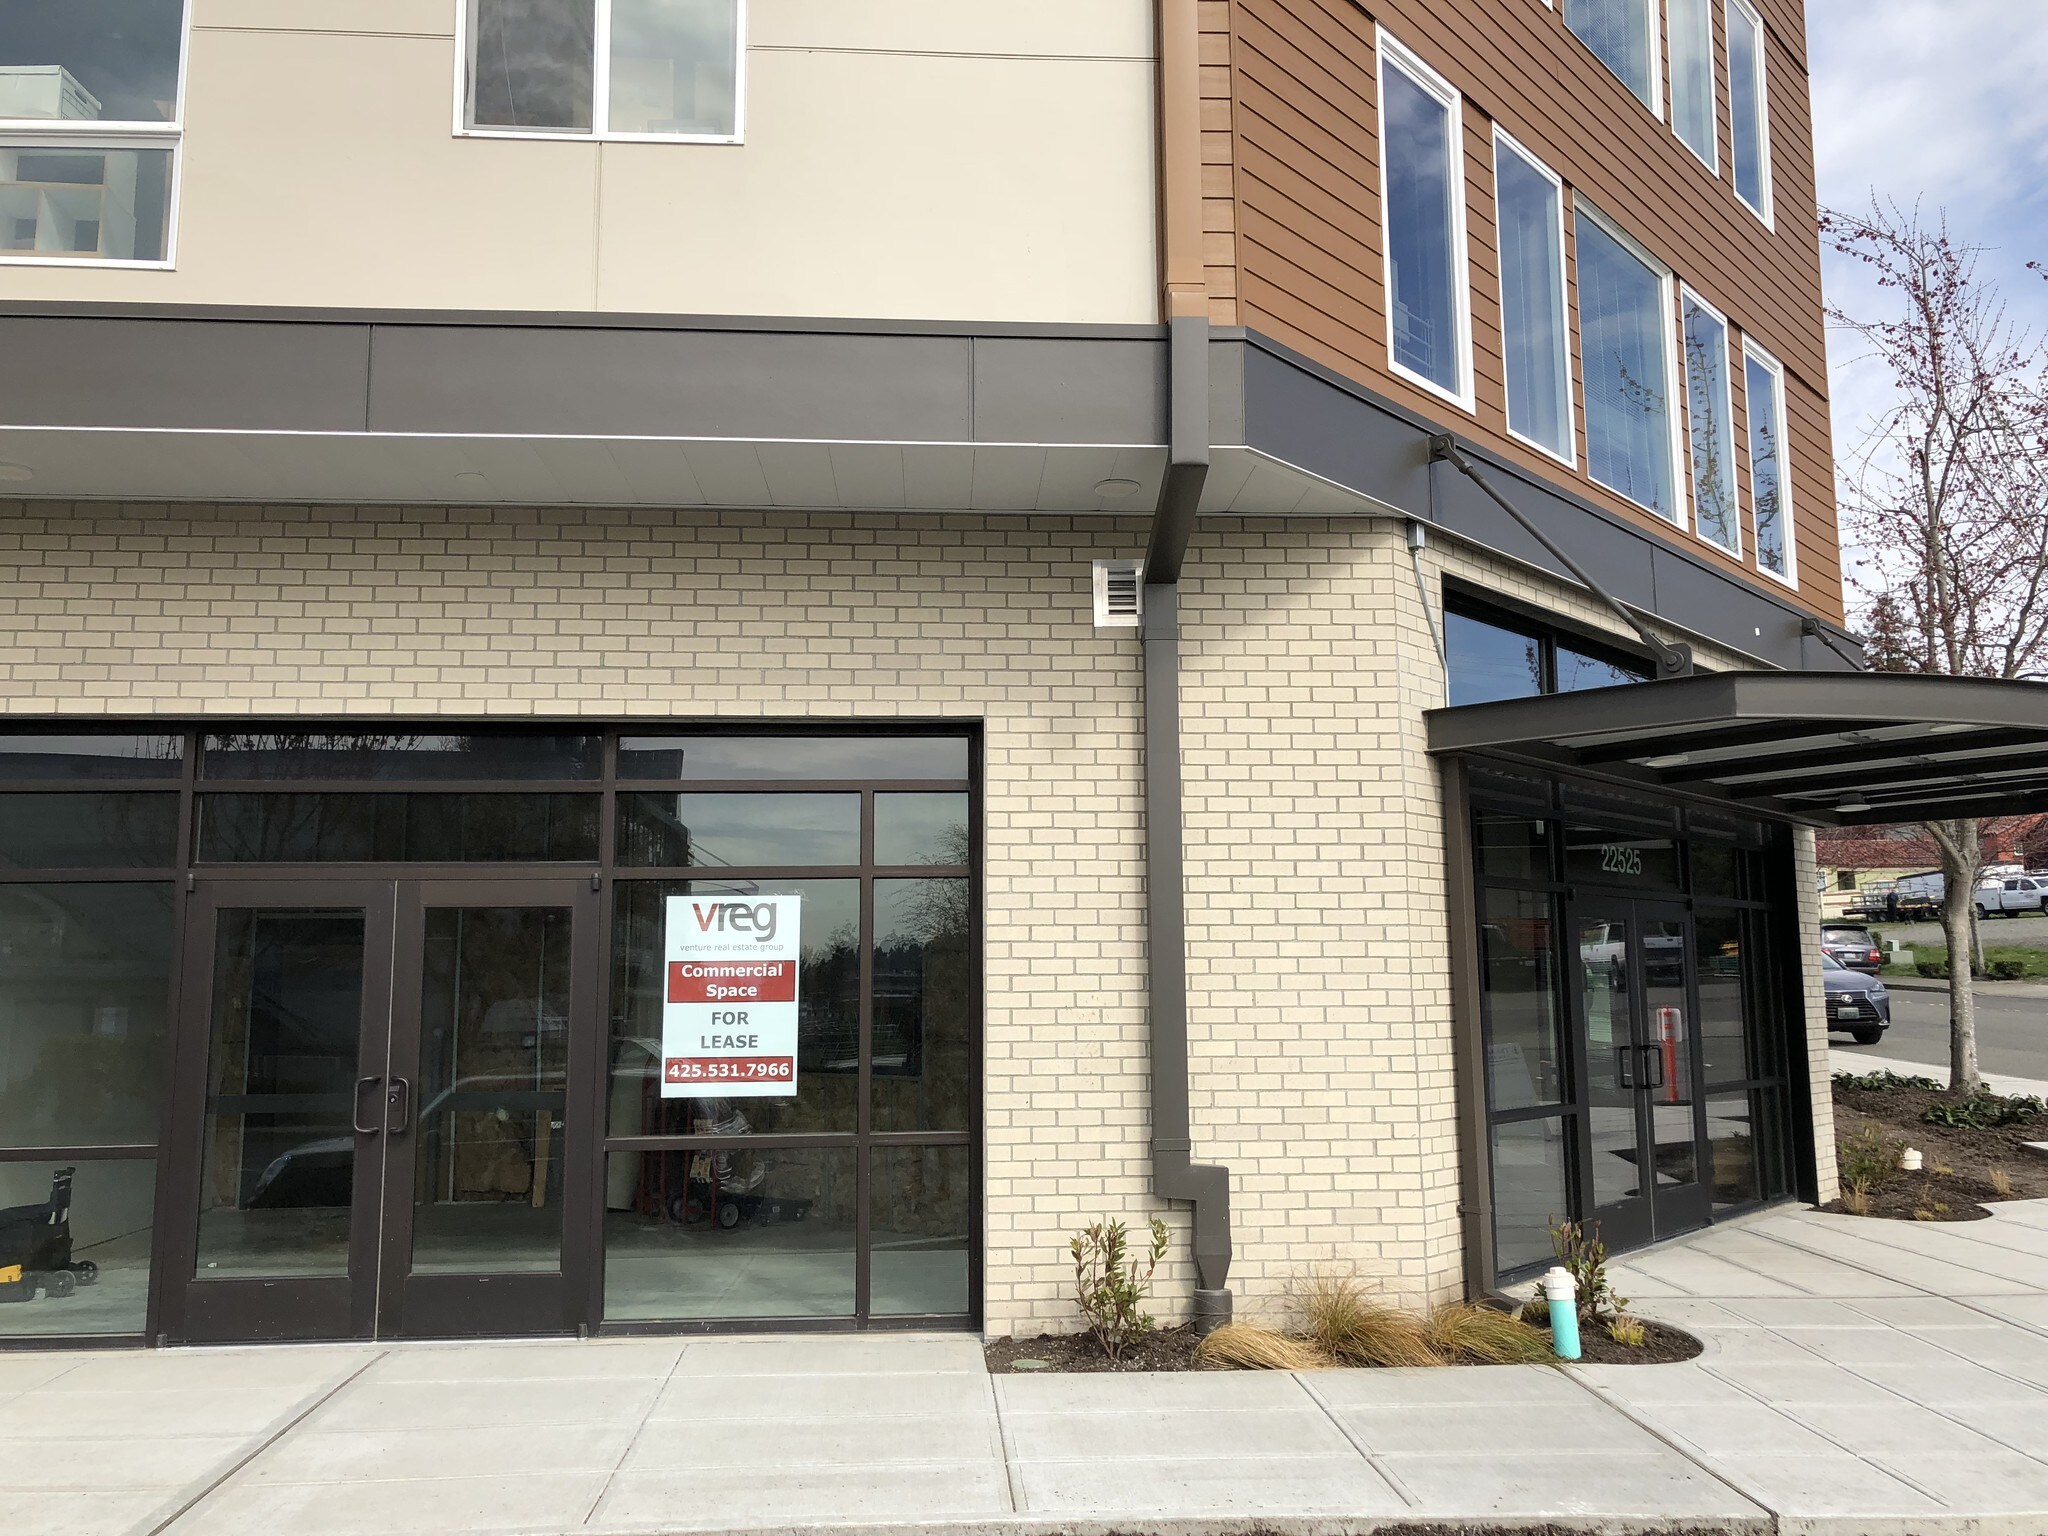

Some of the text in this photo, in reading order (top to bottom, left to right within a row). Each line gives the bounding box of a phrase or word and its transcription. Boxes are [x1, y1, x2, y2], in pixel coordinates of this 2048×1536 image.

[1601, 844, 1642, 875] 22525
[692, 902, 777, 942] vreg
[680, 944, 712, 952] venture
[760, 944, 784, 952] group
[681, 963, 783, 978] Commercial
[706, 984, 758, 999] Space
[711, 1011, 750, 1025] FOR
[700, 1035, 759, 1049] LEASE
[668, 1062, 790, 1078] 425.531.7966
